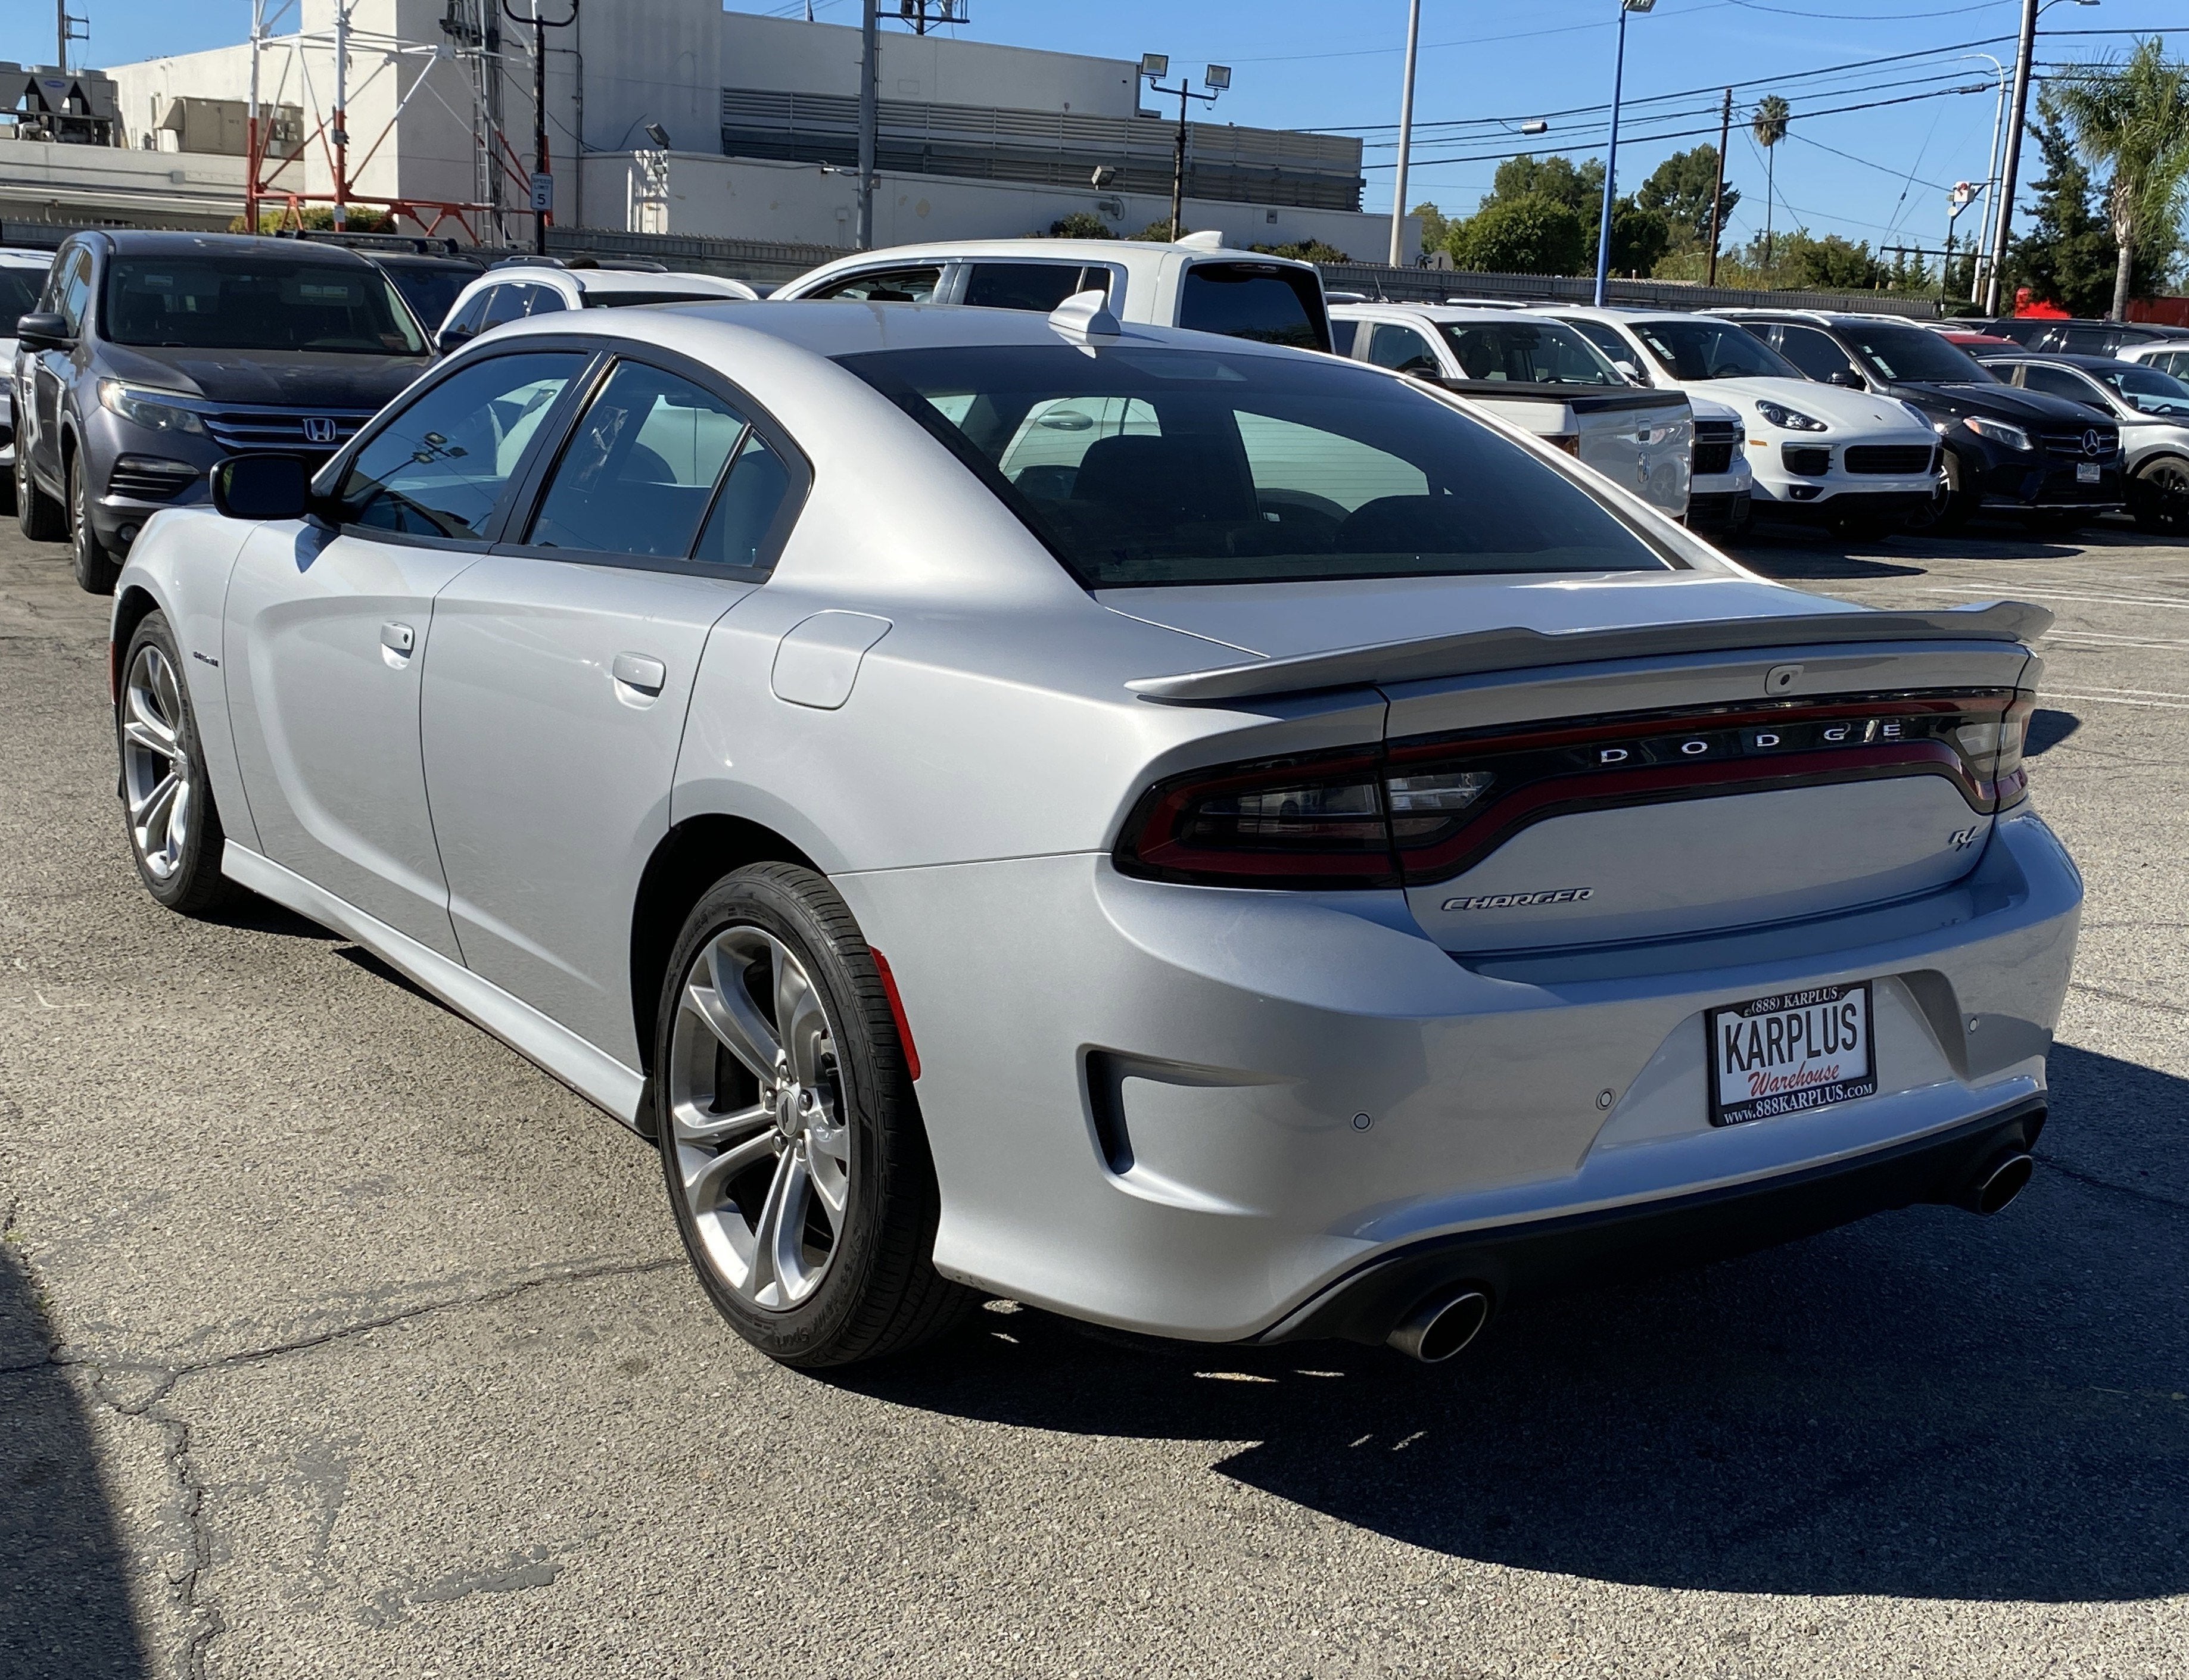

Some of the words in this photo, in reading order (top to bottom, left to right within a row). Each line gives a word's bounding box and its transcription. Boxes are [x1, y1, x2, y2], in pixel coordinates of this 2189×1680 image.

[537, 194, 546, 205] 5
[1601, 724, 1901, 763] DODGE
[1441, 887, 1595, 912] CHARGER
[1751, 997, 1780, 1014] (888)
[1784, 986, 1838, 1008] KARPLUS
[1725, 1003, 1858, 1074] KARPLUS
[1748, 1060, 1839, 1097] Warehouse
